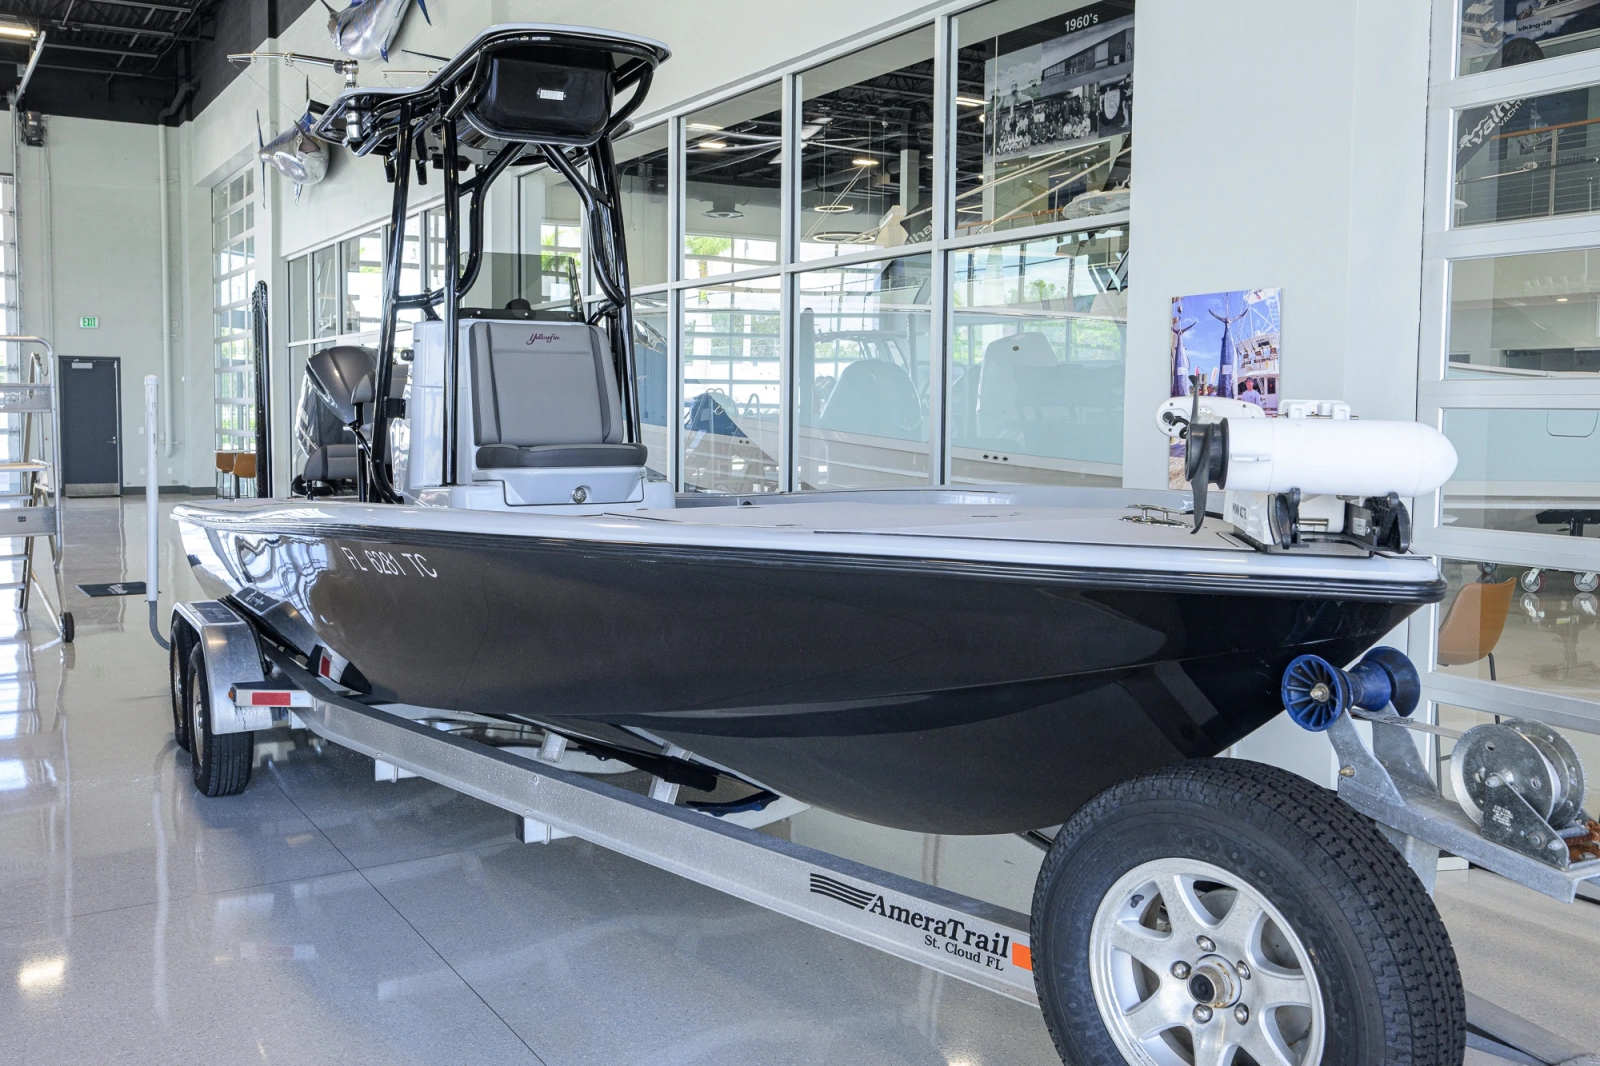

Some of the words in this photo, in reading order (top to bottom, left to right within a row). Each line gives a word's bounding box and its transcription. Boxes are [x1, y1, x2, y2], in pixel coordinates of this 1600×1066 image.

[1065, 13, 1099, 32] 1960's
[83, 317, 96, 327] EXIT
[340, 546, 369, 571] FL
[364, 549, 407, 576] 6281
[401, 552, 438, 578] TC
[869, 895, 1010, 959] AmeraTrail
[924, 935, 941, 949] St.
[945, 942, 981, 964] Cloud
[986, 956, 1004, 972] FL
